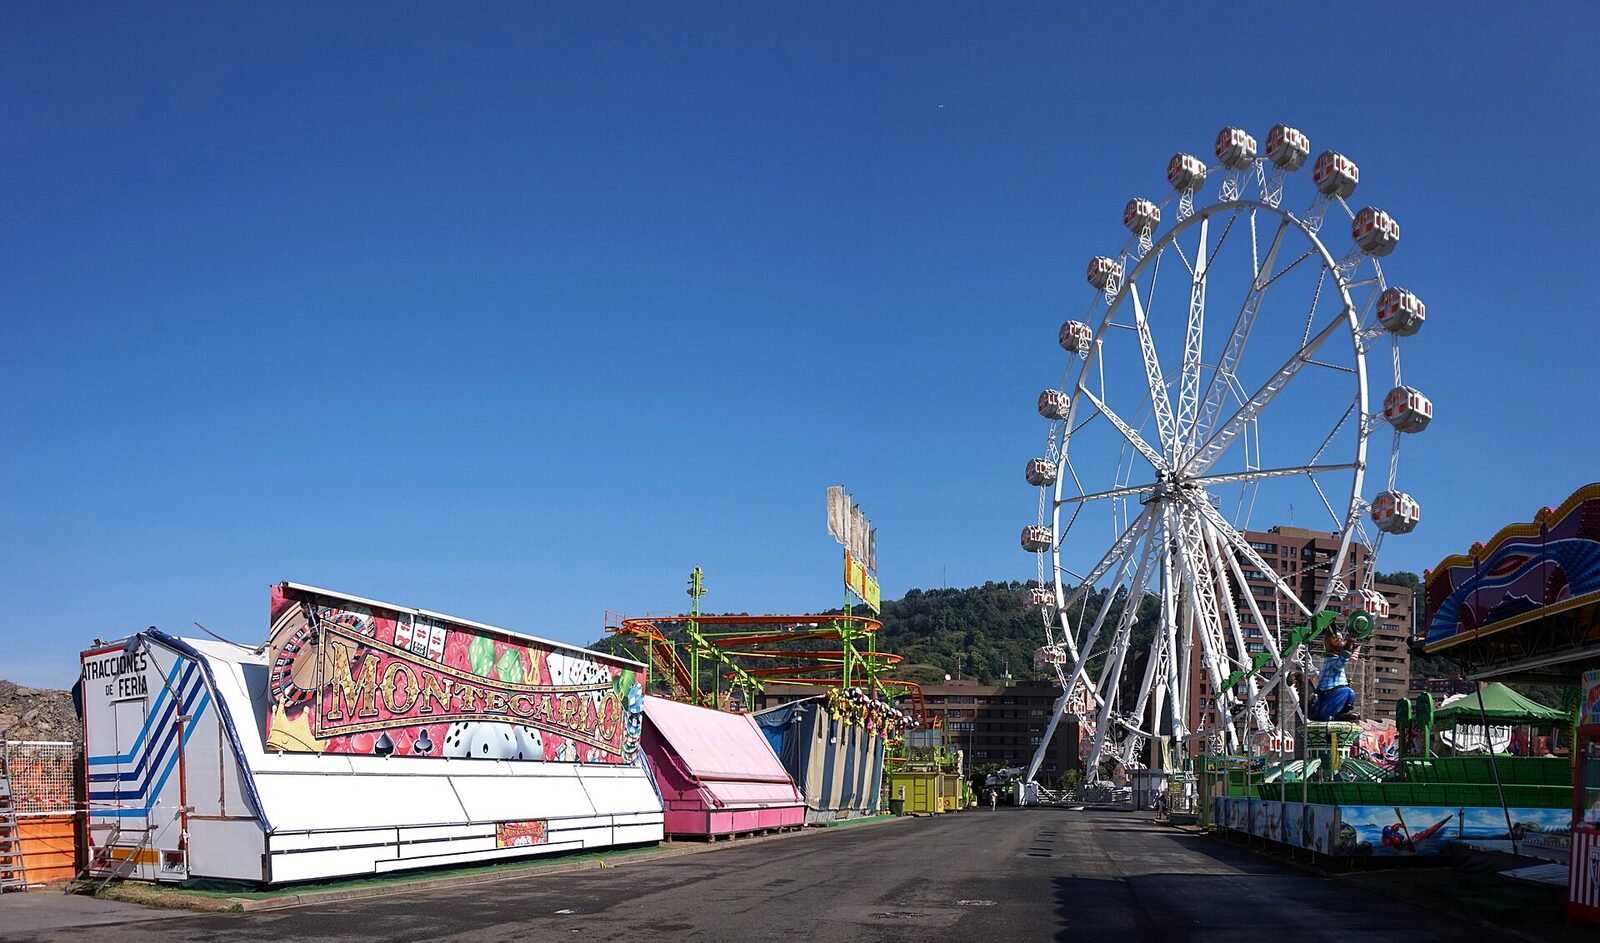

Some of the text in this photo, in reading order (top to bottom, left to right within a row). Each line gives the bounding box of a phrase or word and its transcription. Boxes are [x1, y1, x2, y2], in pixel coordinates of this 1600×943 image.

[82, 652, 147, 681] ATRACCIONES
[105, 675, 148, 697] DE FERIA
[327, 641, 619, 741] MONTECARLO
